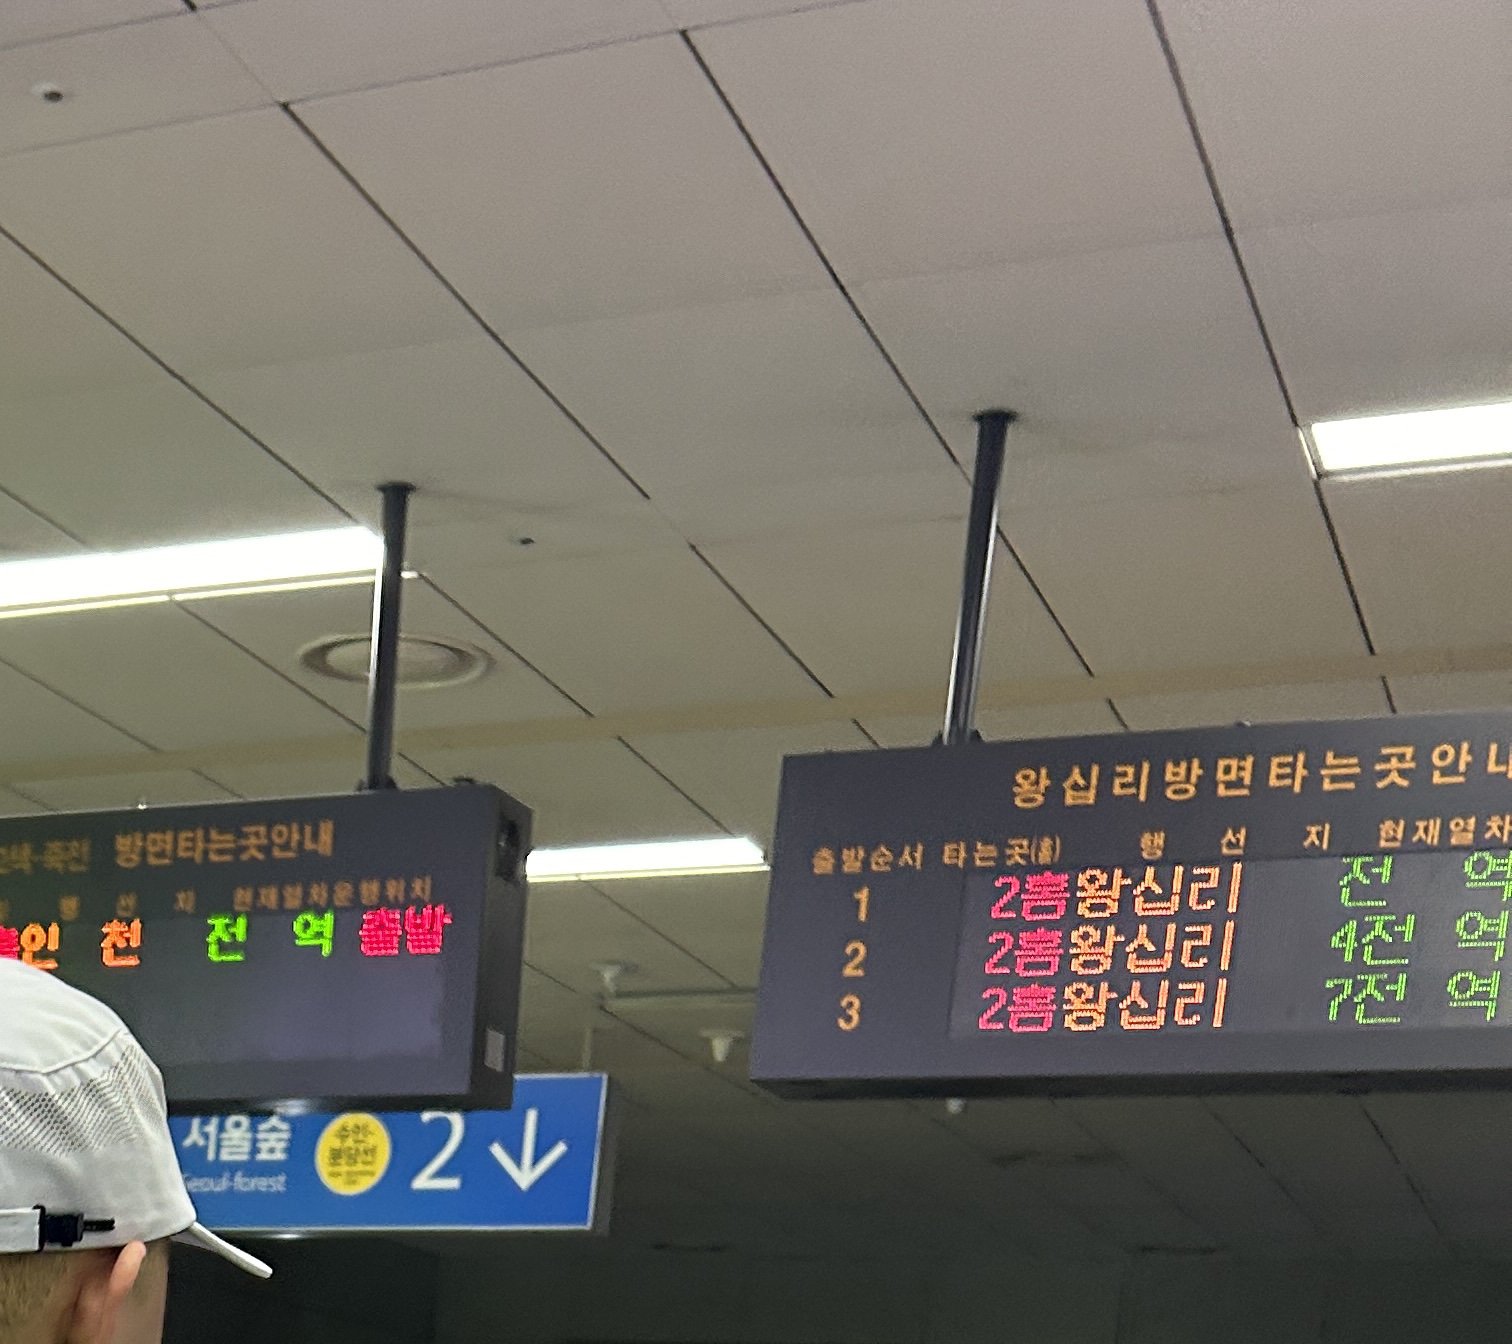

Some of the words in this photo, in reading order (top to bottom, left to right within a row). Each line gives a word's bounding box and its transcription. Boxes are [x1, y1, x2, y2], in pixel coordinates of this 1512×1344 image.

[812, 842, 924, 875] 출발순서
[854, 885, 870, 922] 1
[1076, 861, 1243, 919] 왕십리
[842, 940, 867, 978] 2
[1068, 920, 1236, 975] 왕십리
[837, 993, 861, 1031] 3
[1062, 978, 1228, 1031] 왕십리
[182, 1115, 290, 1161] 서울숲
[410, 1110, 465, 1190] 2
